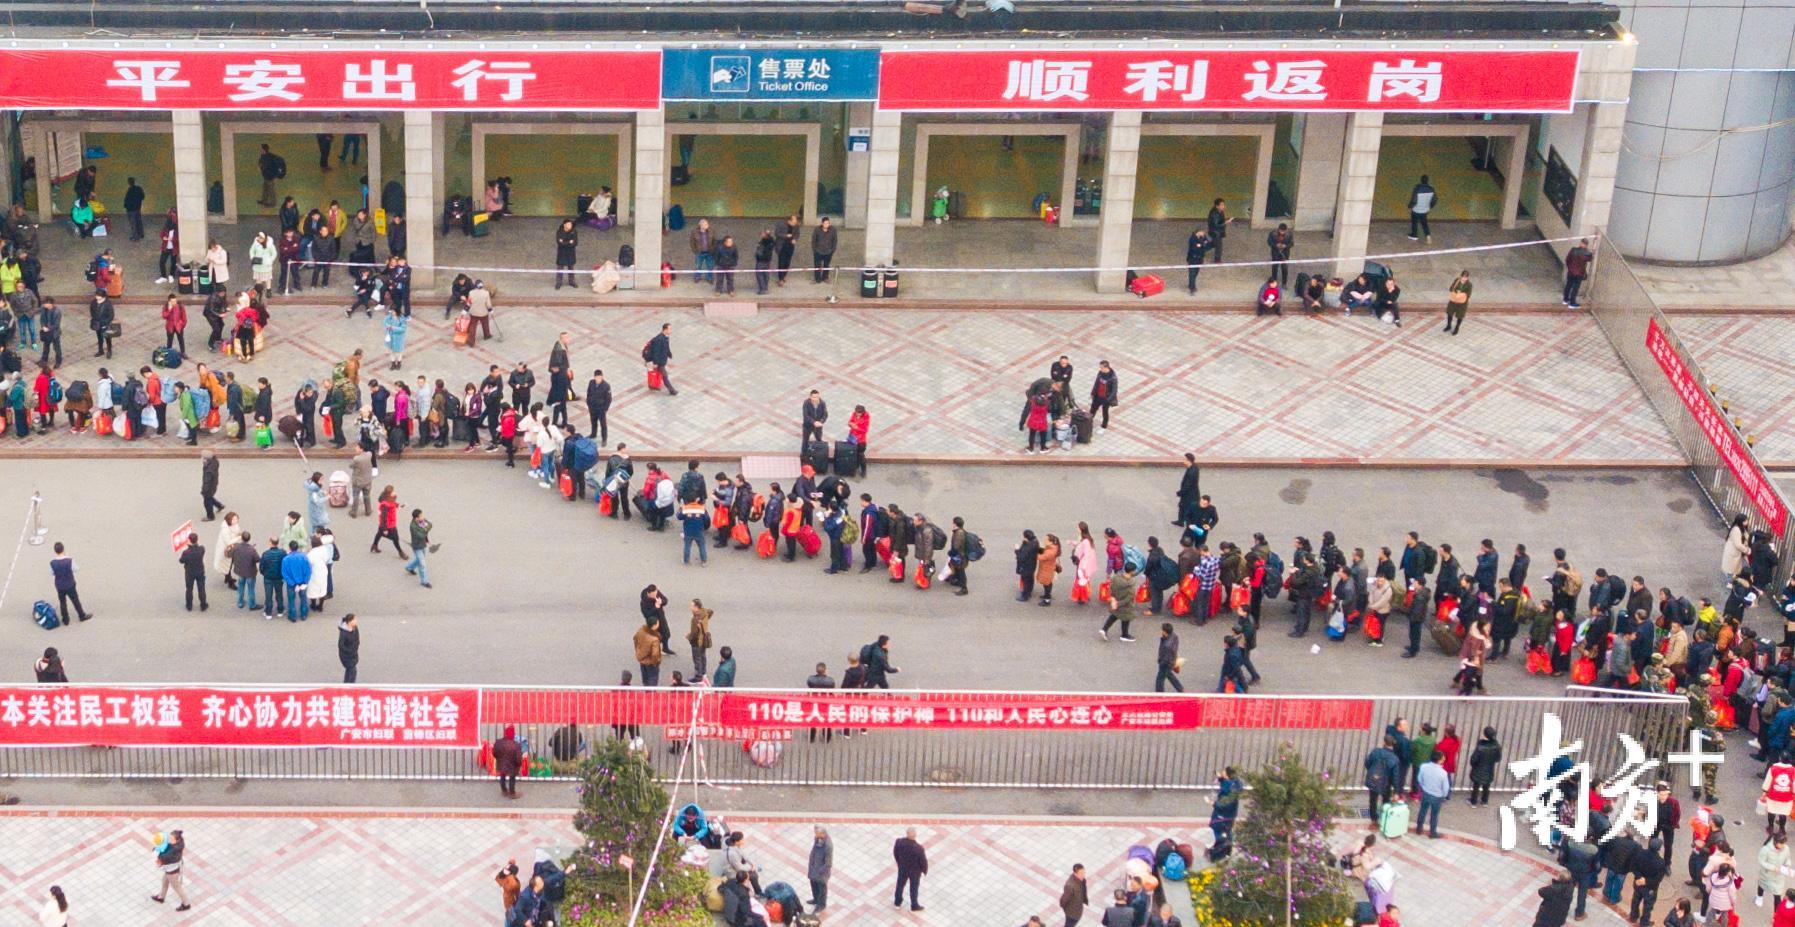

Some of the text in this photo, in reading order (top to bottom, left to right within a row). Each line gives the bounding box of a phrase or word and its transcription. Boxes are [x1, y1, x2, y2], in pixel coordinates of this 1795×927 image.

[106, 59, 537, 102] 平安出行
[758, 58, 831, 79] 售票处
[1003, 59, 1443, 103] 顺利返岗
[758, 81, 828, 91] Ticket Office
[1, 694, 459, 728] 本关注民工权益 齐心协力共建和谐社会
[748, 702, 1113, 724] 110是人民的保护神 110和人民心连心
